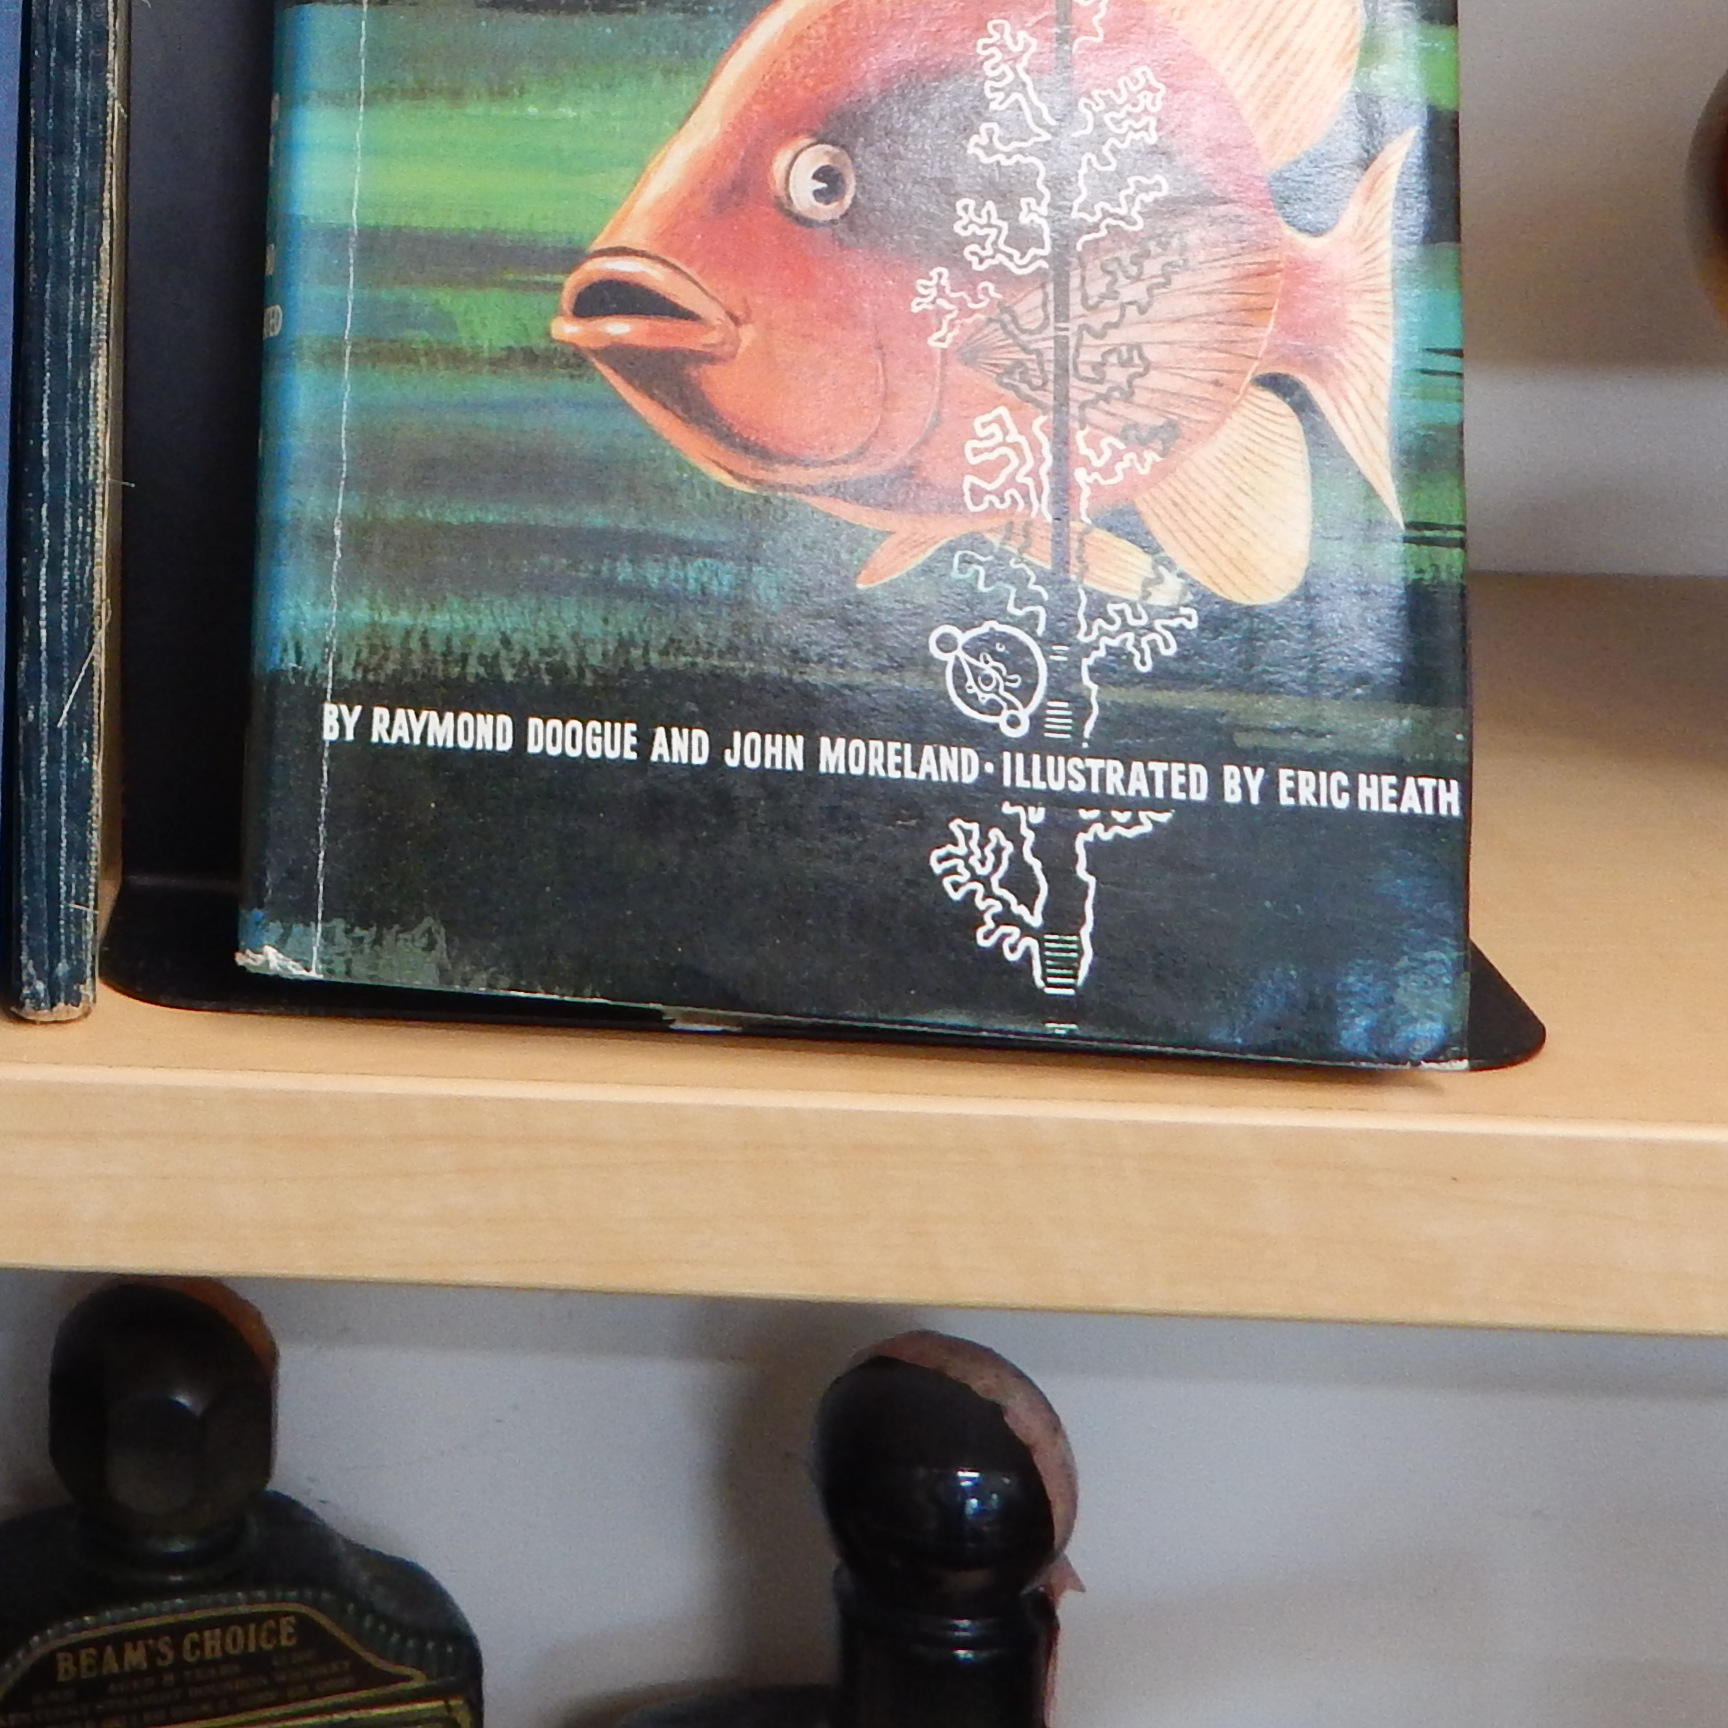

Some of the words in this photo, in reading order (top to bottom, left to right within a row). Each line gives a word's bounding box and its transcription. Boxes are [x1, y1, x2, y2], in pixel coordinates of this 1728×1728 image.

[323, 702, 363, 742] BY
[370, 705, 514, 752] RAYMOND
[526, 717, 639, 761] DOOGUE
[649, 726, 709, 767] AND
[724, 730, 805, 772] JOHN
[818, 735, 975, 785] MORELAND
[1002, 749, 1210, 802] ILLUSTRATED
[1223, 762, 1266, 806] BY
[1277, 768, 1350, 810] ERIC
[1357, 772, 1462, 817] HEATH
[56, 1634, 173, 1683] BEAM'S
[181, 1615, 299, 1664] CHOICE
